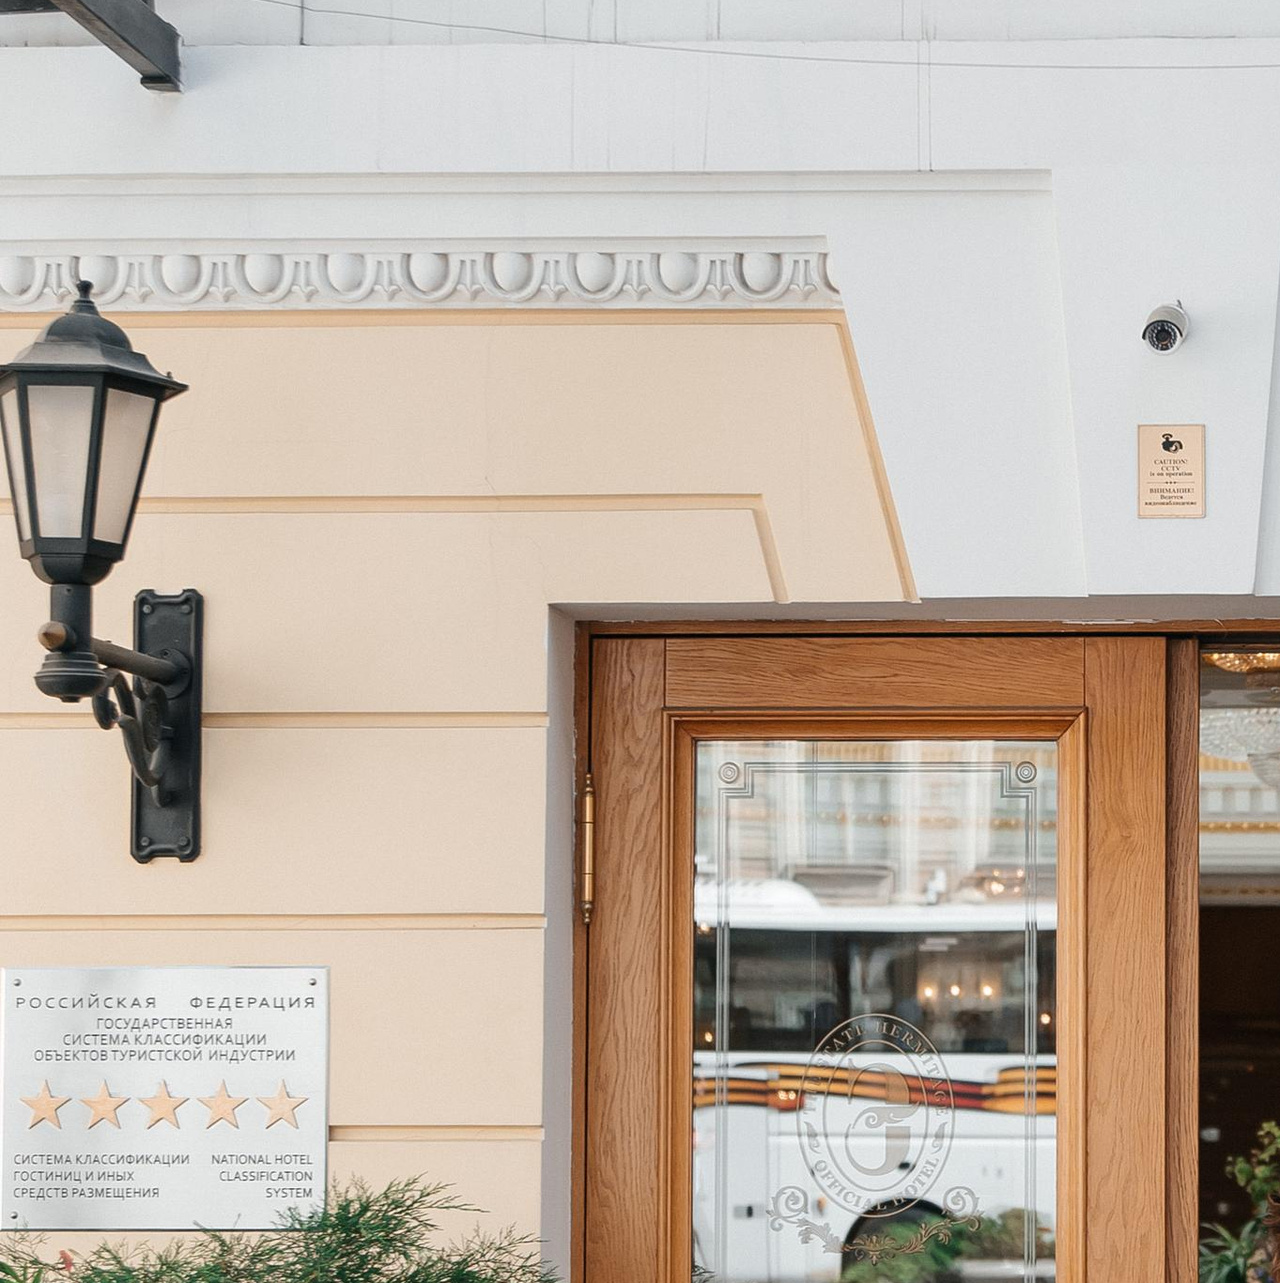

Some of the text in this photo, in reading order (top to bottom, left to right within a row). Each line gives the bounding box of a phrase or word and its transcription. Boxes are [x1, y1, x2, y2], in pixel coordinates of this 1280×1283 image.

[16, 993, 316, 1011] РОССИЙСКАЯ ФЕДЕРАЦИЯ
[96, 1017, 233, 1032] ГОСУДАРСТВЕННАЯ
[62, 1033, 267, 1049] СИСТЕМА КЛАССИФИКАЦИИ
[34, 1046, 296, 1064] ОБЪЕКТОВ ТУРИСТСКОЙ ИНДУСТРИИ
[13, 1154, 190, 1167] СИСТЕМА КЛАССИФИКАЦИИ
[211, 1154, 313, 1165] NATIONAL HOTEL
[13, 1170, 135, 1184] ГОСТИНИЦ И ИНЫХ
[219, 1170, 313, 1182] CLASSIFICATION
[814, 1157, 940, 1211] OFFICIAL HOTEL
[13, 1187, 160, 1200] СРЕДСТВ РАЗМЕЩЕНИЯ
[265, 1187, 313, 1198] SYSTEM
